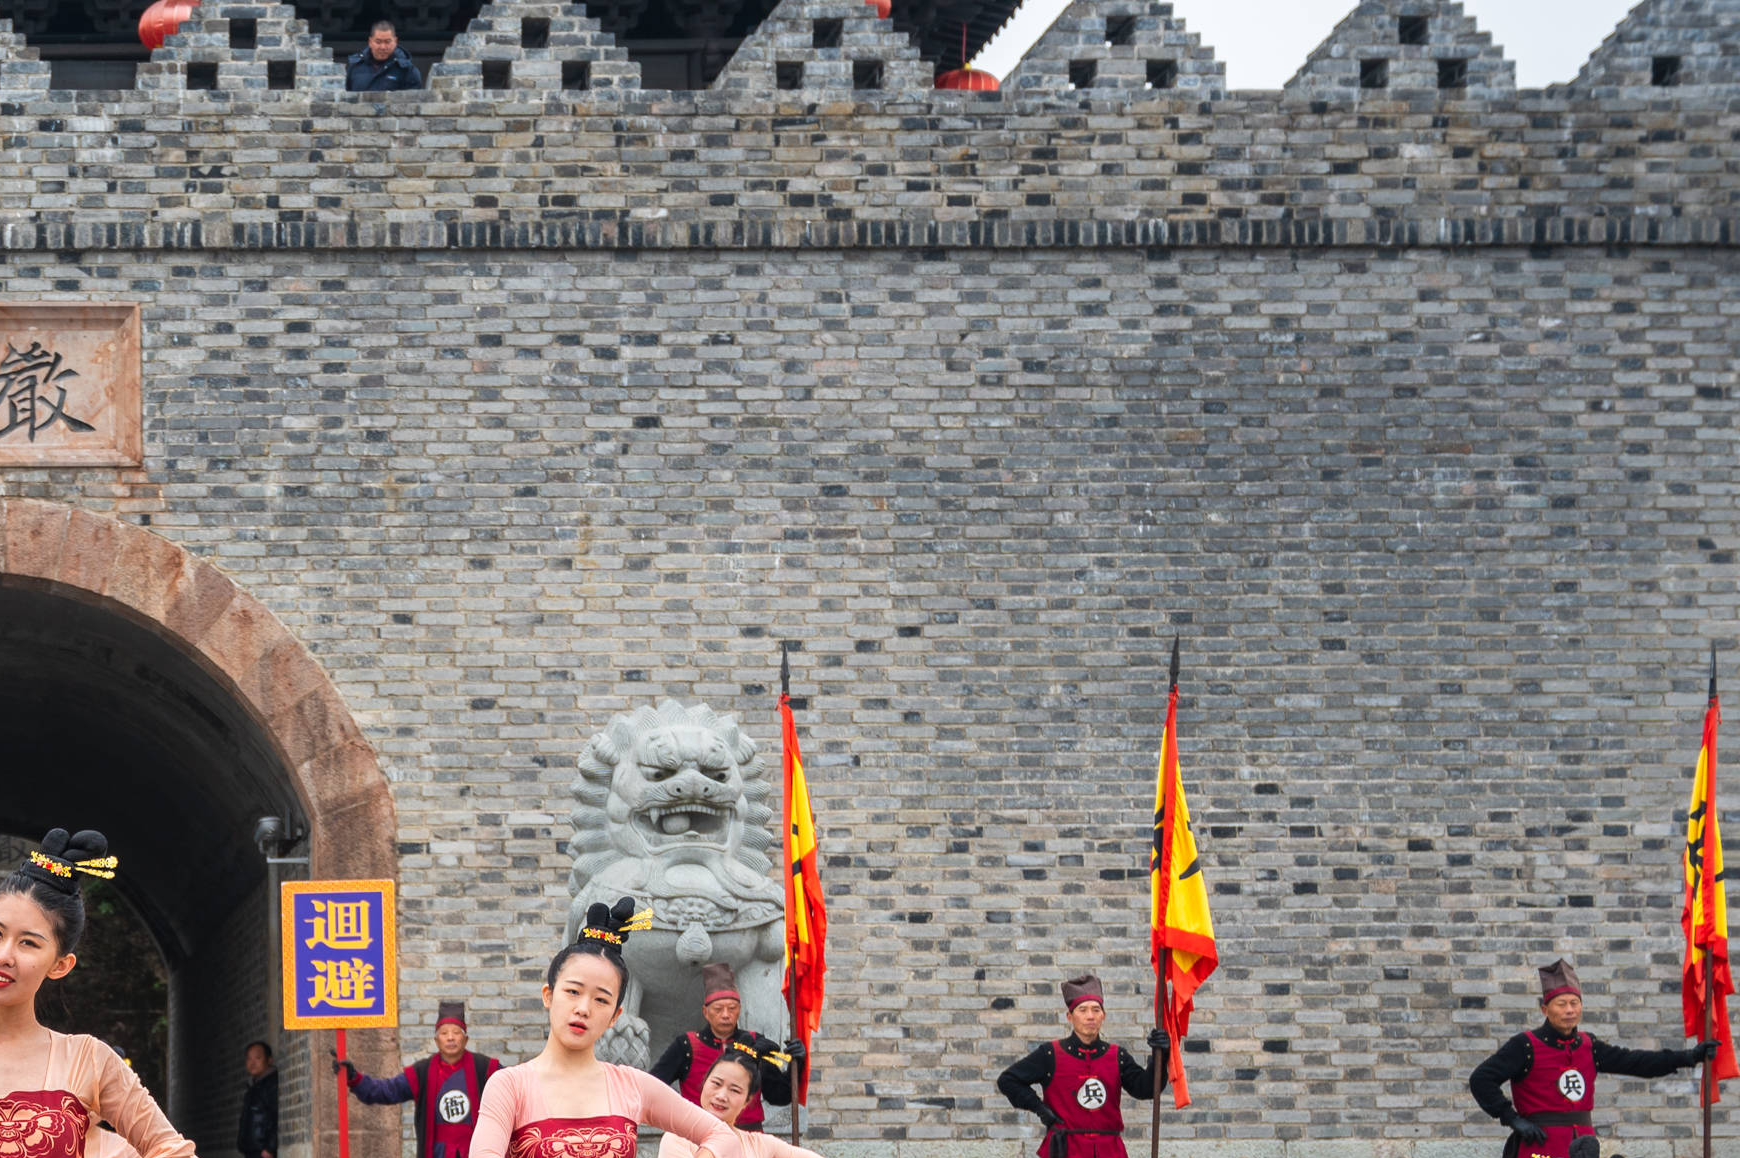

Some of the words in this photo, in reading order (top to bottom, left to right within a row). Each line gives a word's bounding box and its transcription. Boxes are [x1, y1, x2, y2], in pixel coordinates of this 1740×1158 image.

[1083, 1082, 1104, 1104] 兵
[1563, 1074, 1583, 1096] 兵
[443, 1094, 466, 1118] 衙
